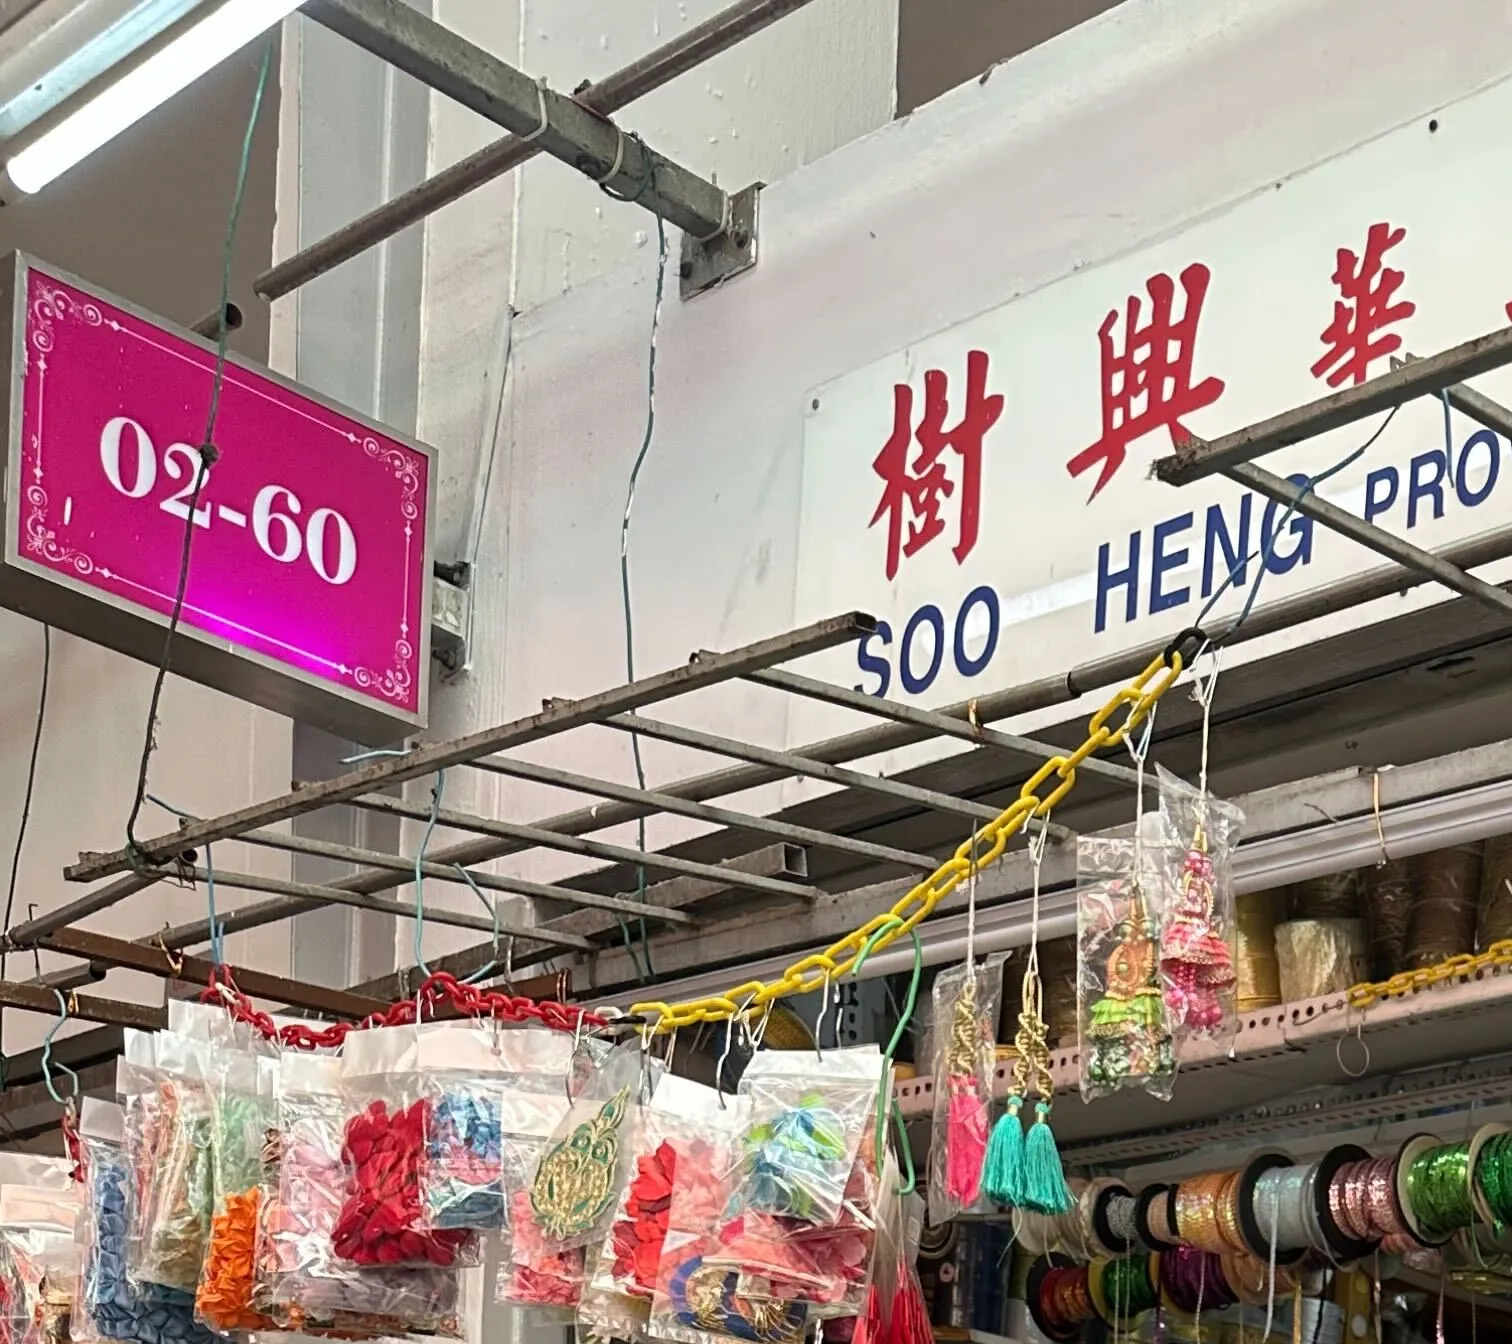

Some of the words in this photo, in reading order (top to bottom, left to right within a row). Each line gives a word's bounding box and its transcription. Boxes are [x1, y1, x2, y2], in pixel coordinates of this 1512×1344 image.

[100, 416, 357, 585] 02-60
[854, 585, 1000, 698] SOO
[1094, 473, 1314, 634] HENG
